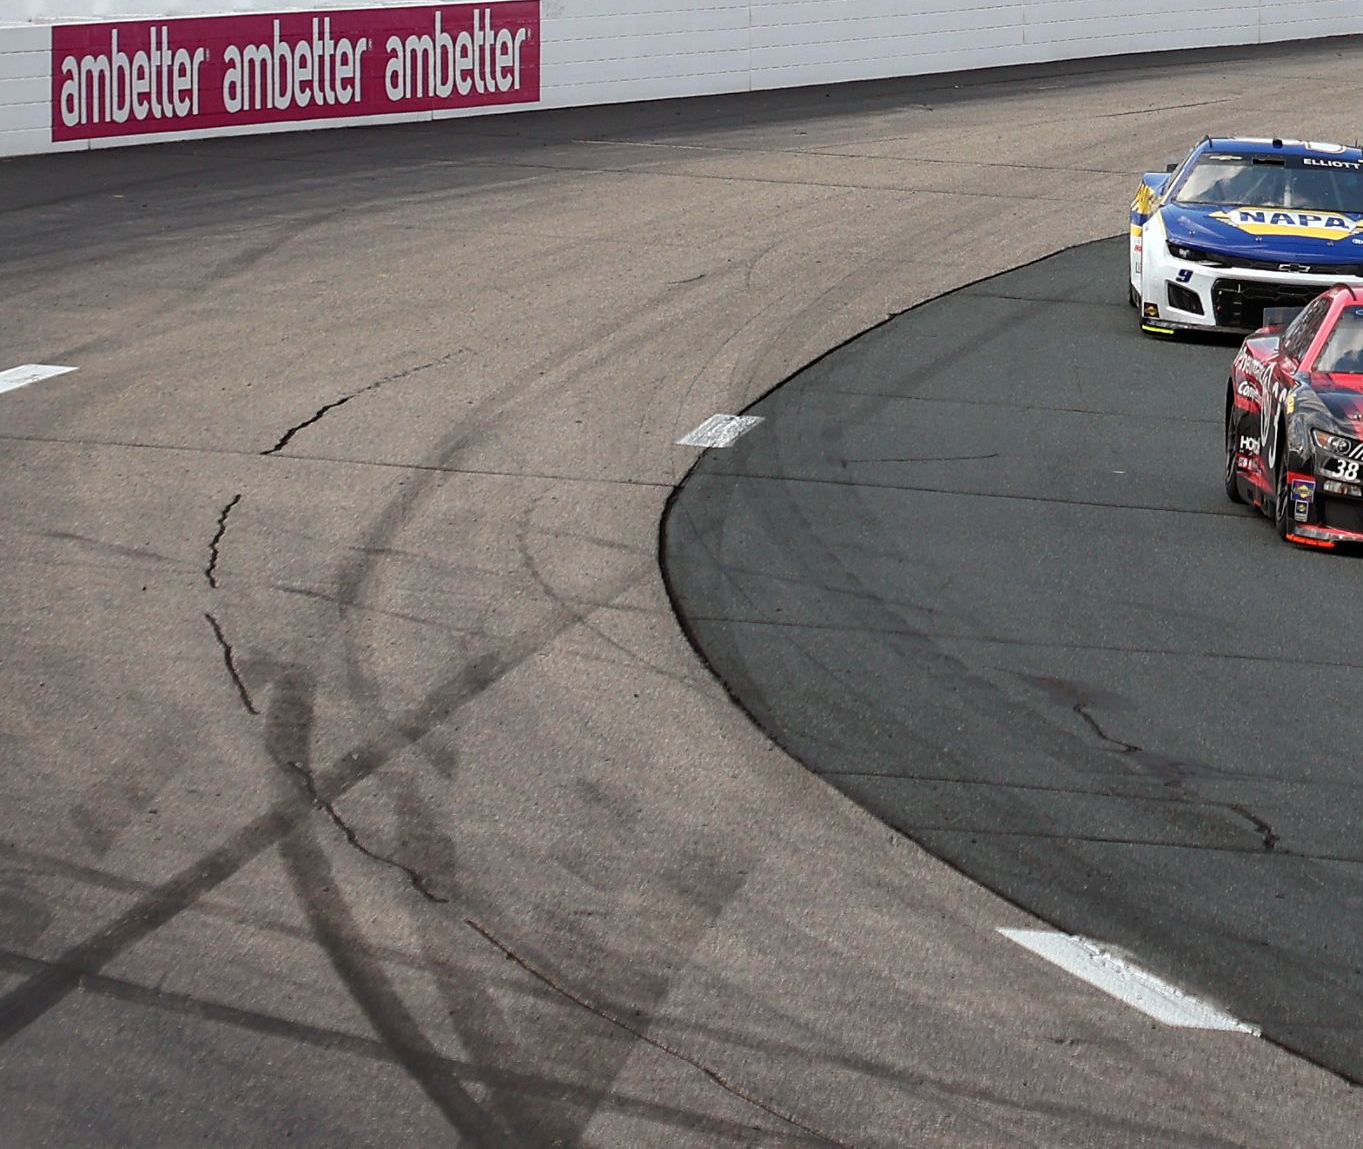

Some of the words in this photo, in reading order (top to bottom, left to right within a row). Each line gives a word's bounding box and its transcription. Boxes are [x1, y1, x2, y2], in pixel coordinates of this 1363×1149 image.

[60, 25, 204, 128] ambetter
[222, 17, 367, 113] ambetter
[385, 7, 527, 102] ambetter
[1302, 157, 1361, 171] ELLIOTT
[1239, 211, 1349, 229] NAPA
[1175, 268, 1195, 283] 9
[1331, 459, 1360, 481] 38
